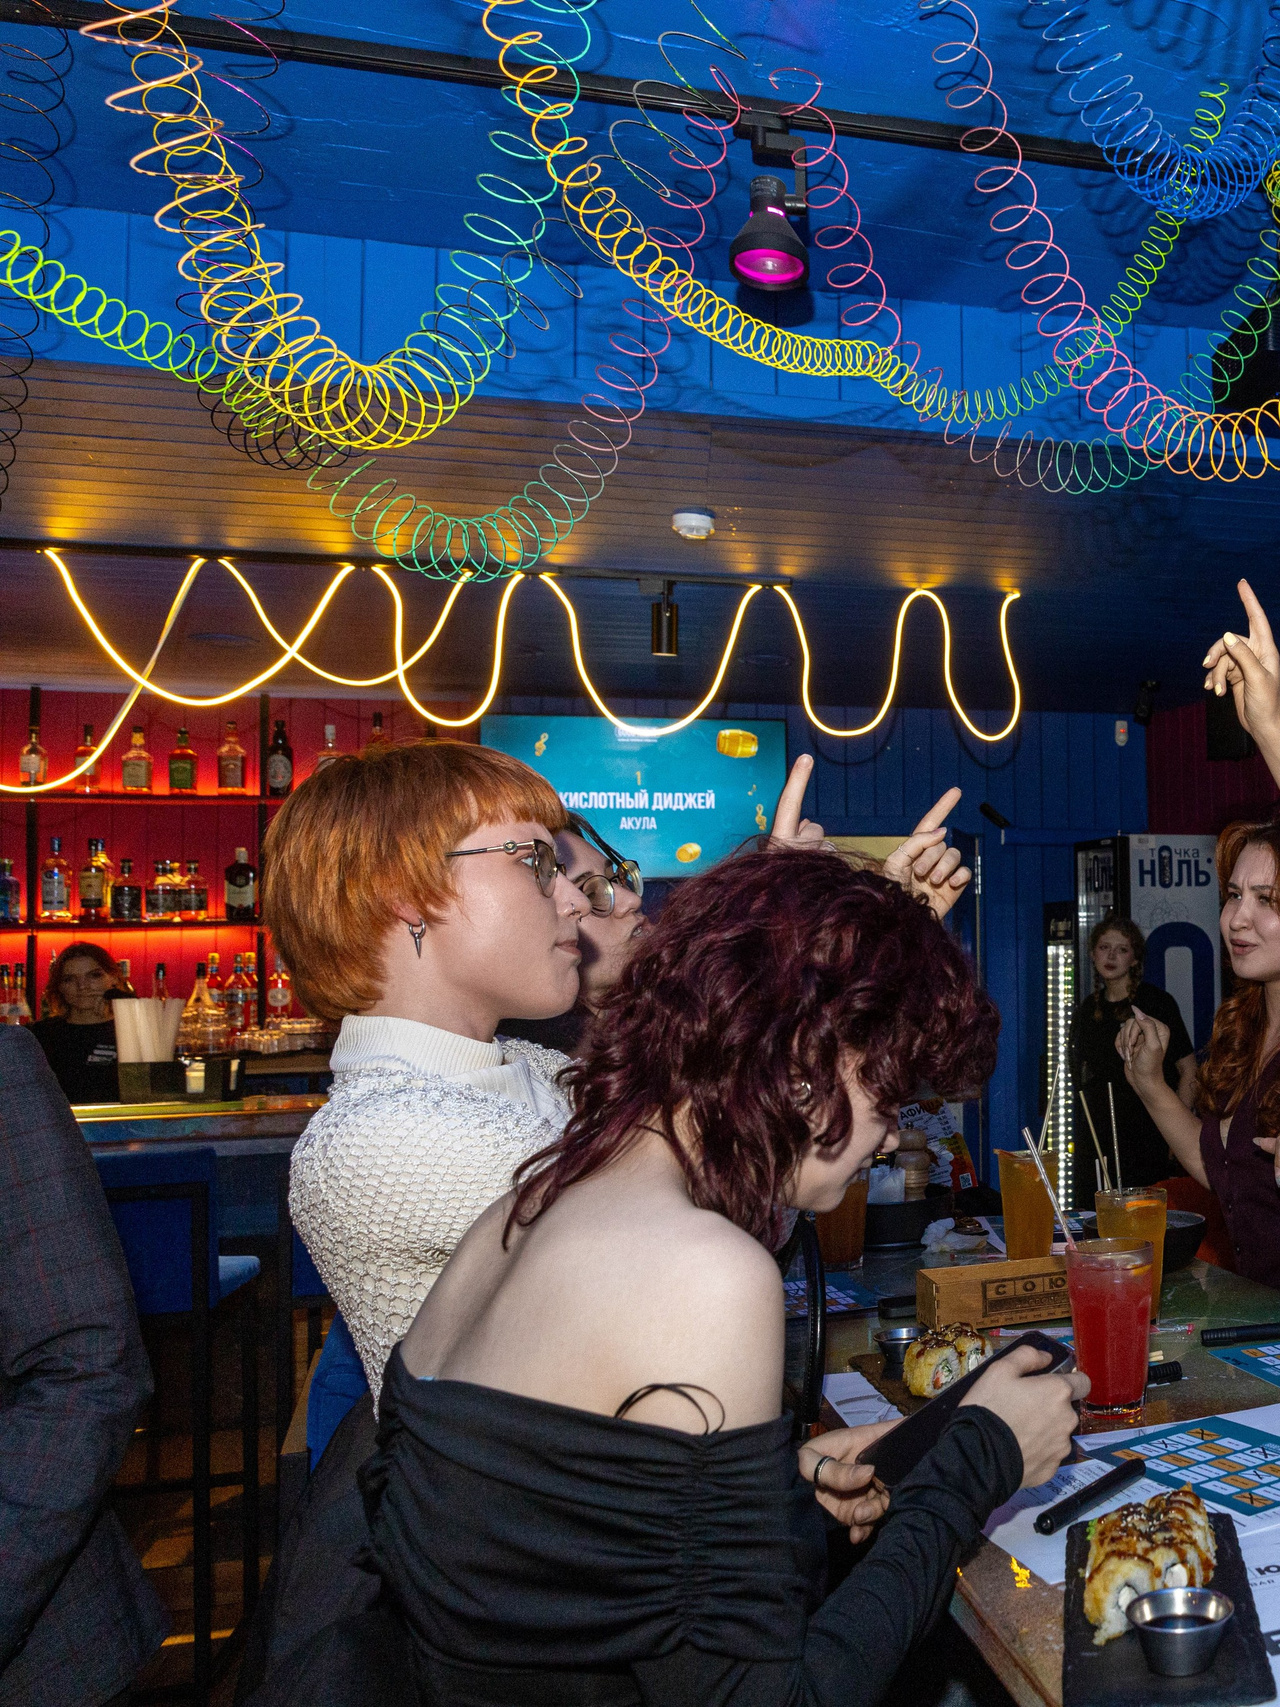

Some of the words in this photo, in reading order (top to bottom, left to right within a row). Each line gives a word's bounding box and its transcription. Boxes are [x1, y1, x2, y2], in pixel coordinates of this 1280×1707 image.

[635, 771, 641, 785] 1
[559, 789, 649, 809] КИСЛОТНЫЙ
[652, 790, 715, 810] ДИДЖЕЙ
[620, 817, 657, 830] АКУЛА
[995, 1277, 1067, 1295] СОЮ
